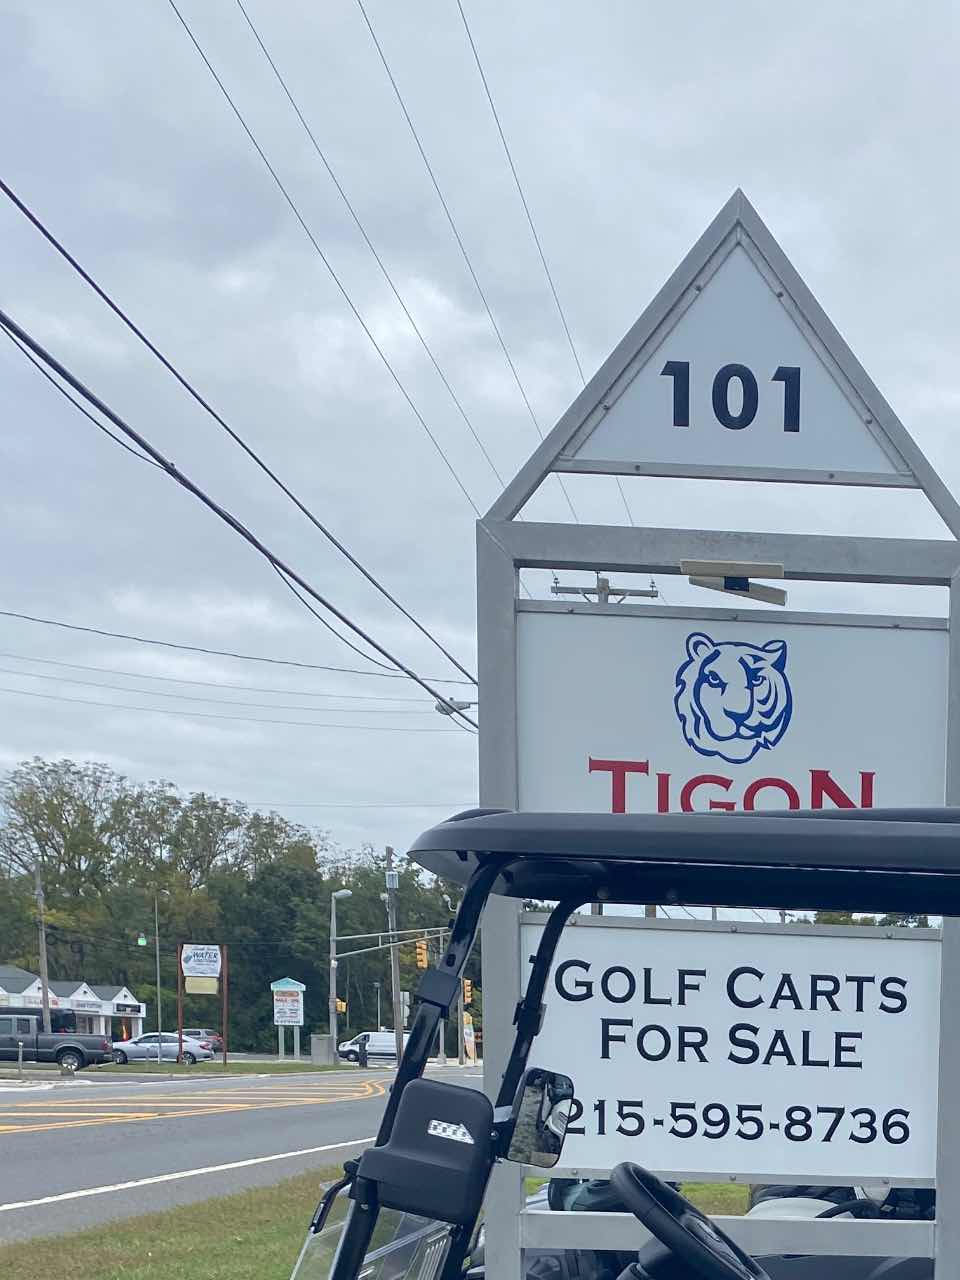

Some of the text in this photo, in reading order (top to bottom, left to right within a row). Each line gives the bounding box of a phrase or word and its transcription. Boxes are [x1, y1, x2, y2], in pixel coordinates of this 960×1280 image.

[660, 360, 801, 433] 101
[588, 756, 876, 814] TIGON
[554, 959, 908, 1014] GOLF CARTS
[600, 1017, 864, 1069] FOR SALE
[566, 1098, 911, 1145] 215-595-8736
